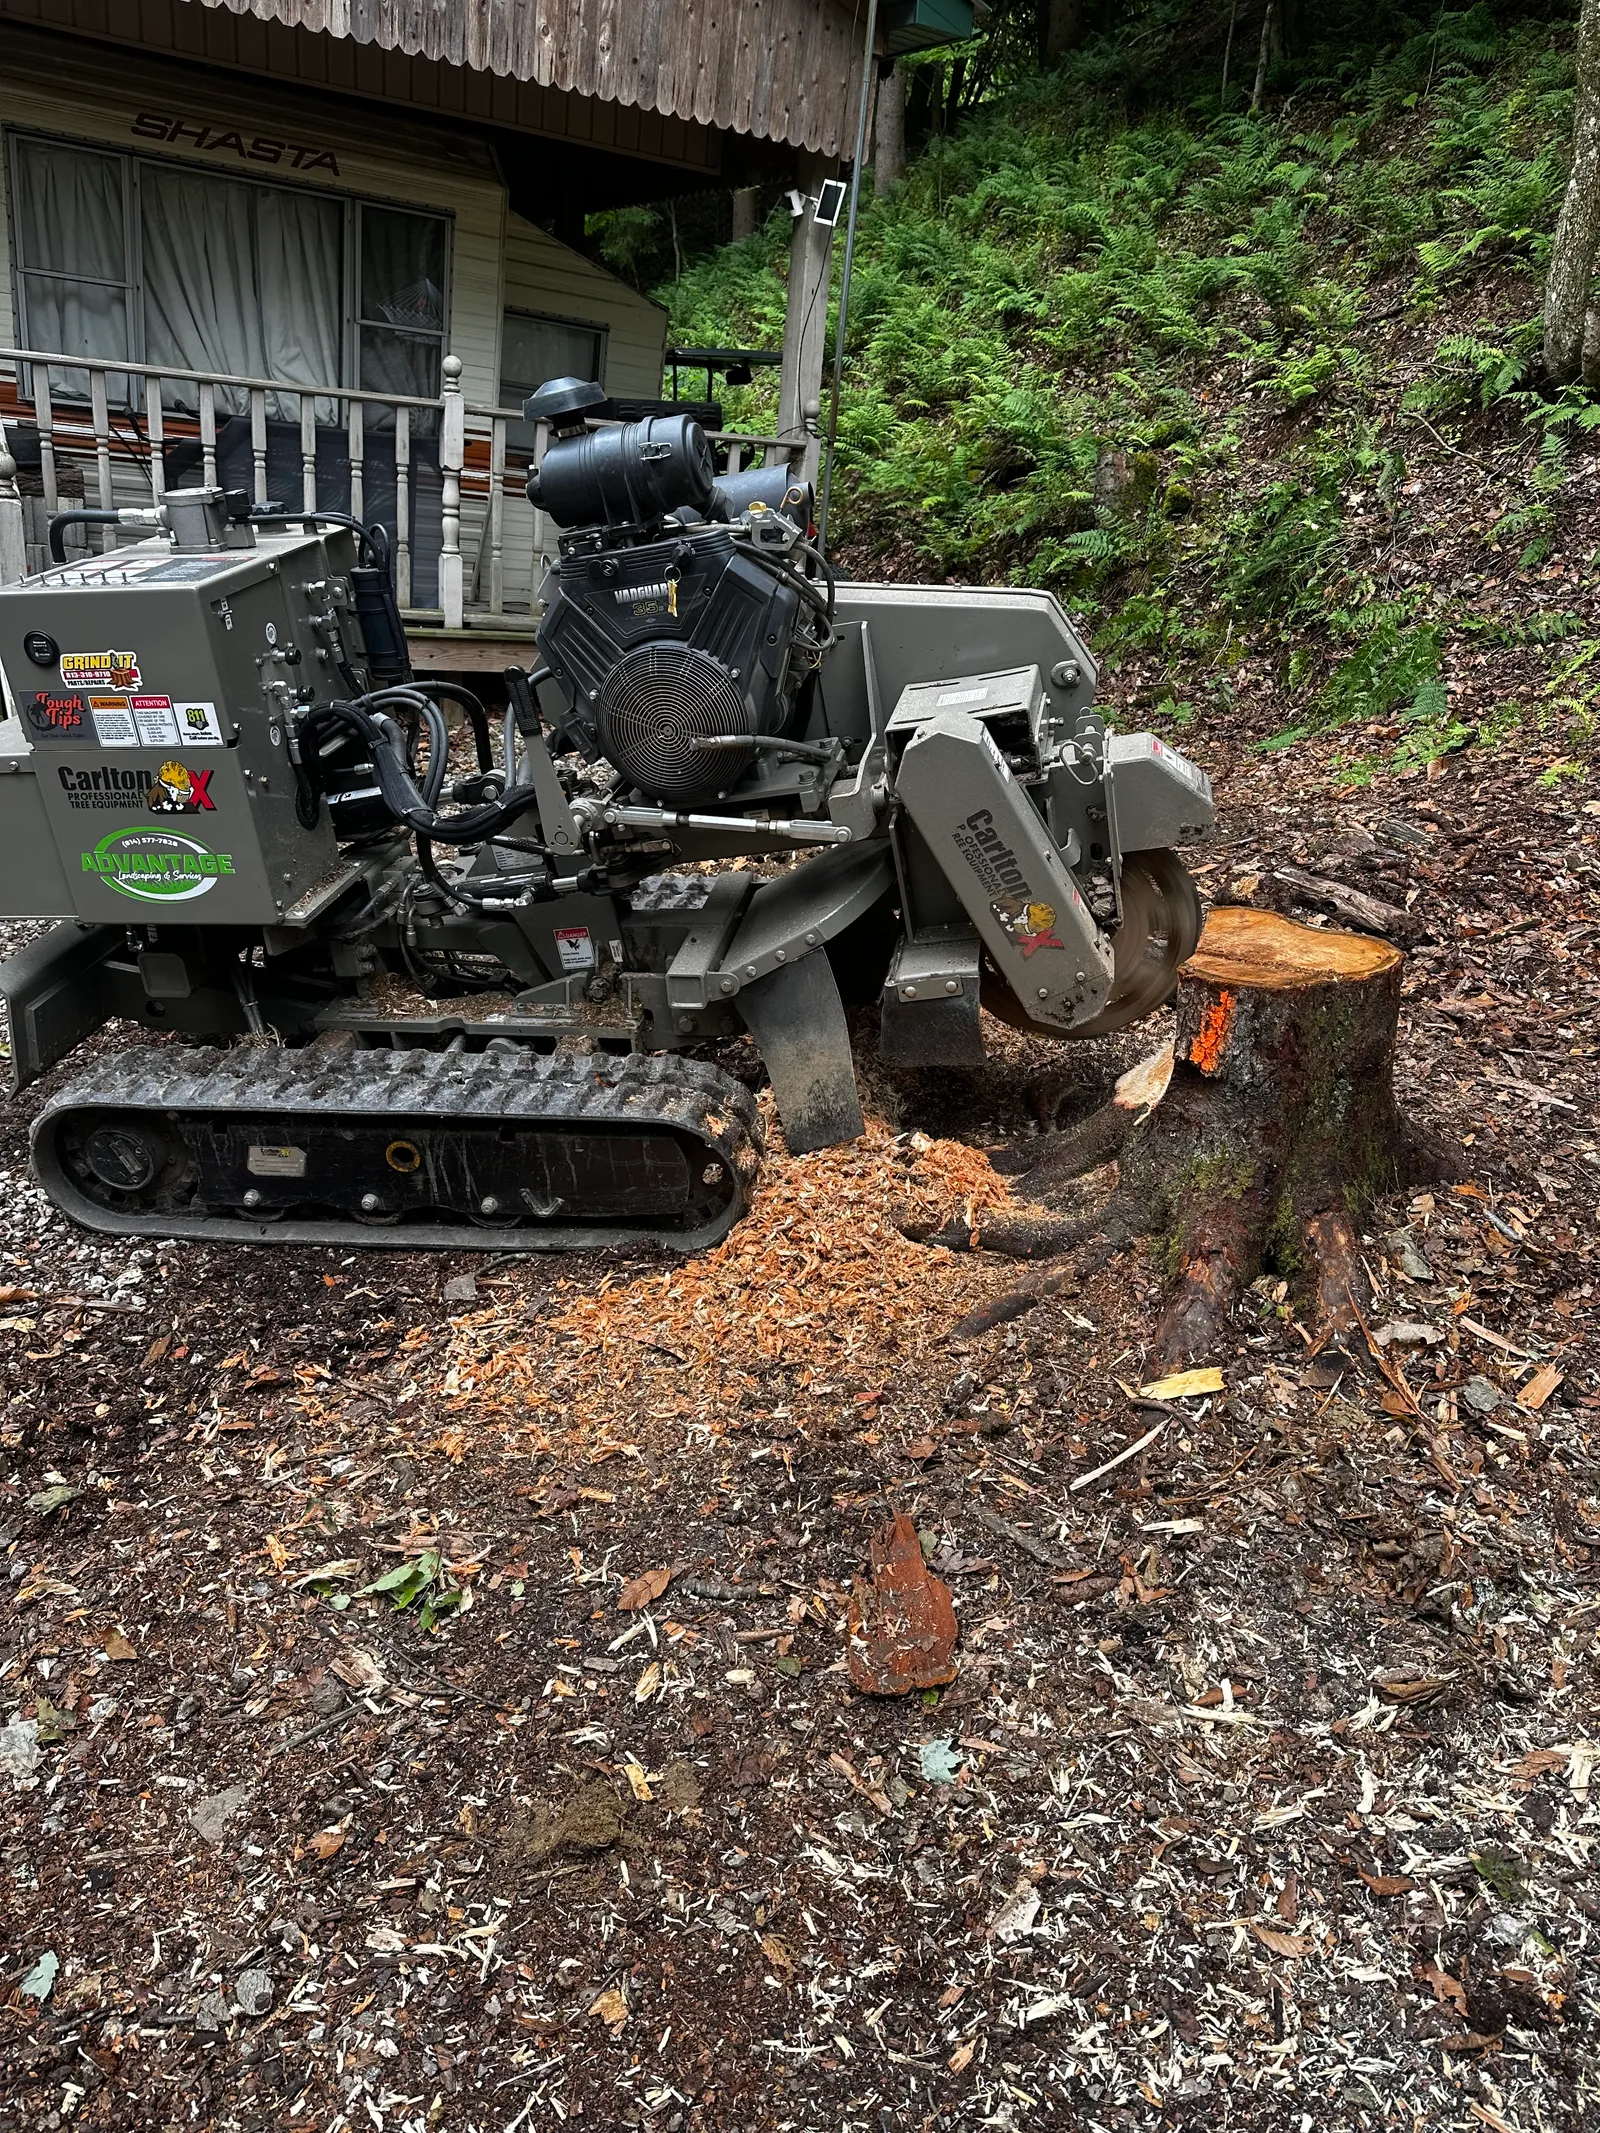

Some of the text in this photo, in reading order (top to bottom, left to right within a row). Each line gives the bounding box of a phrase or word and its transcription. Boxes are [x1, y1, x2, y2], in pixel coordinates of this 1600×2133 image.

[131, 112, 341, 177] SHASTA
[614, 582, 669, 604] VANGUAR
[632, 600, 659, 616] 35
[62, 654, 134, 670] GRIND IT
[65, 671, 111, 679] 813-310-9710
[35, 692, 85, 715] Tough
[45, 707, 82, 730] Tips
[187, 709, 206, 722] 811
[57, 766, 151, 791] Carlton
[68, 792, 144, 800] PROFESSIONAL
[71, 800, 144, 809] TREE EQUIPMENT
[81, 852, 236, 875] ADVANTAGE
[952, 833, 998, 897] REE EQUIPMENT
[957, 823, 1008, 893] POFESSIONAL
[966, 808, 1032, 900] Carlton
[118, 870, 202, 882] Landscaping & Services
